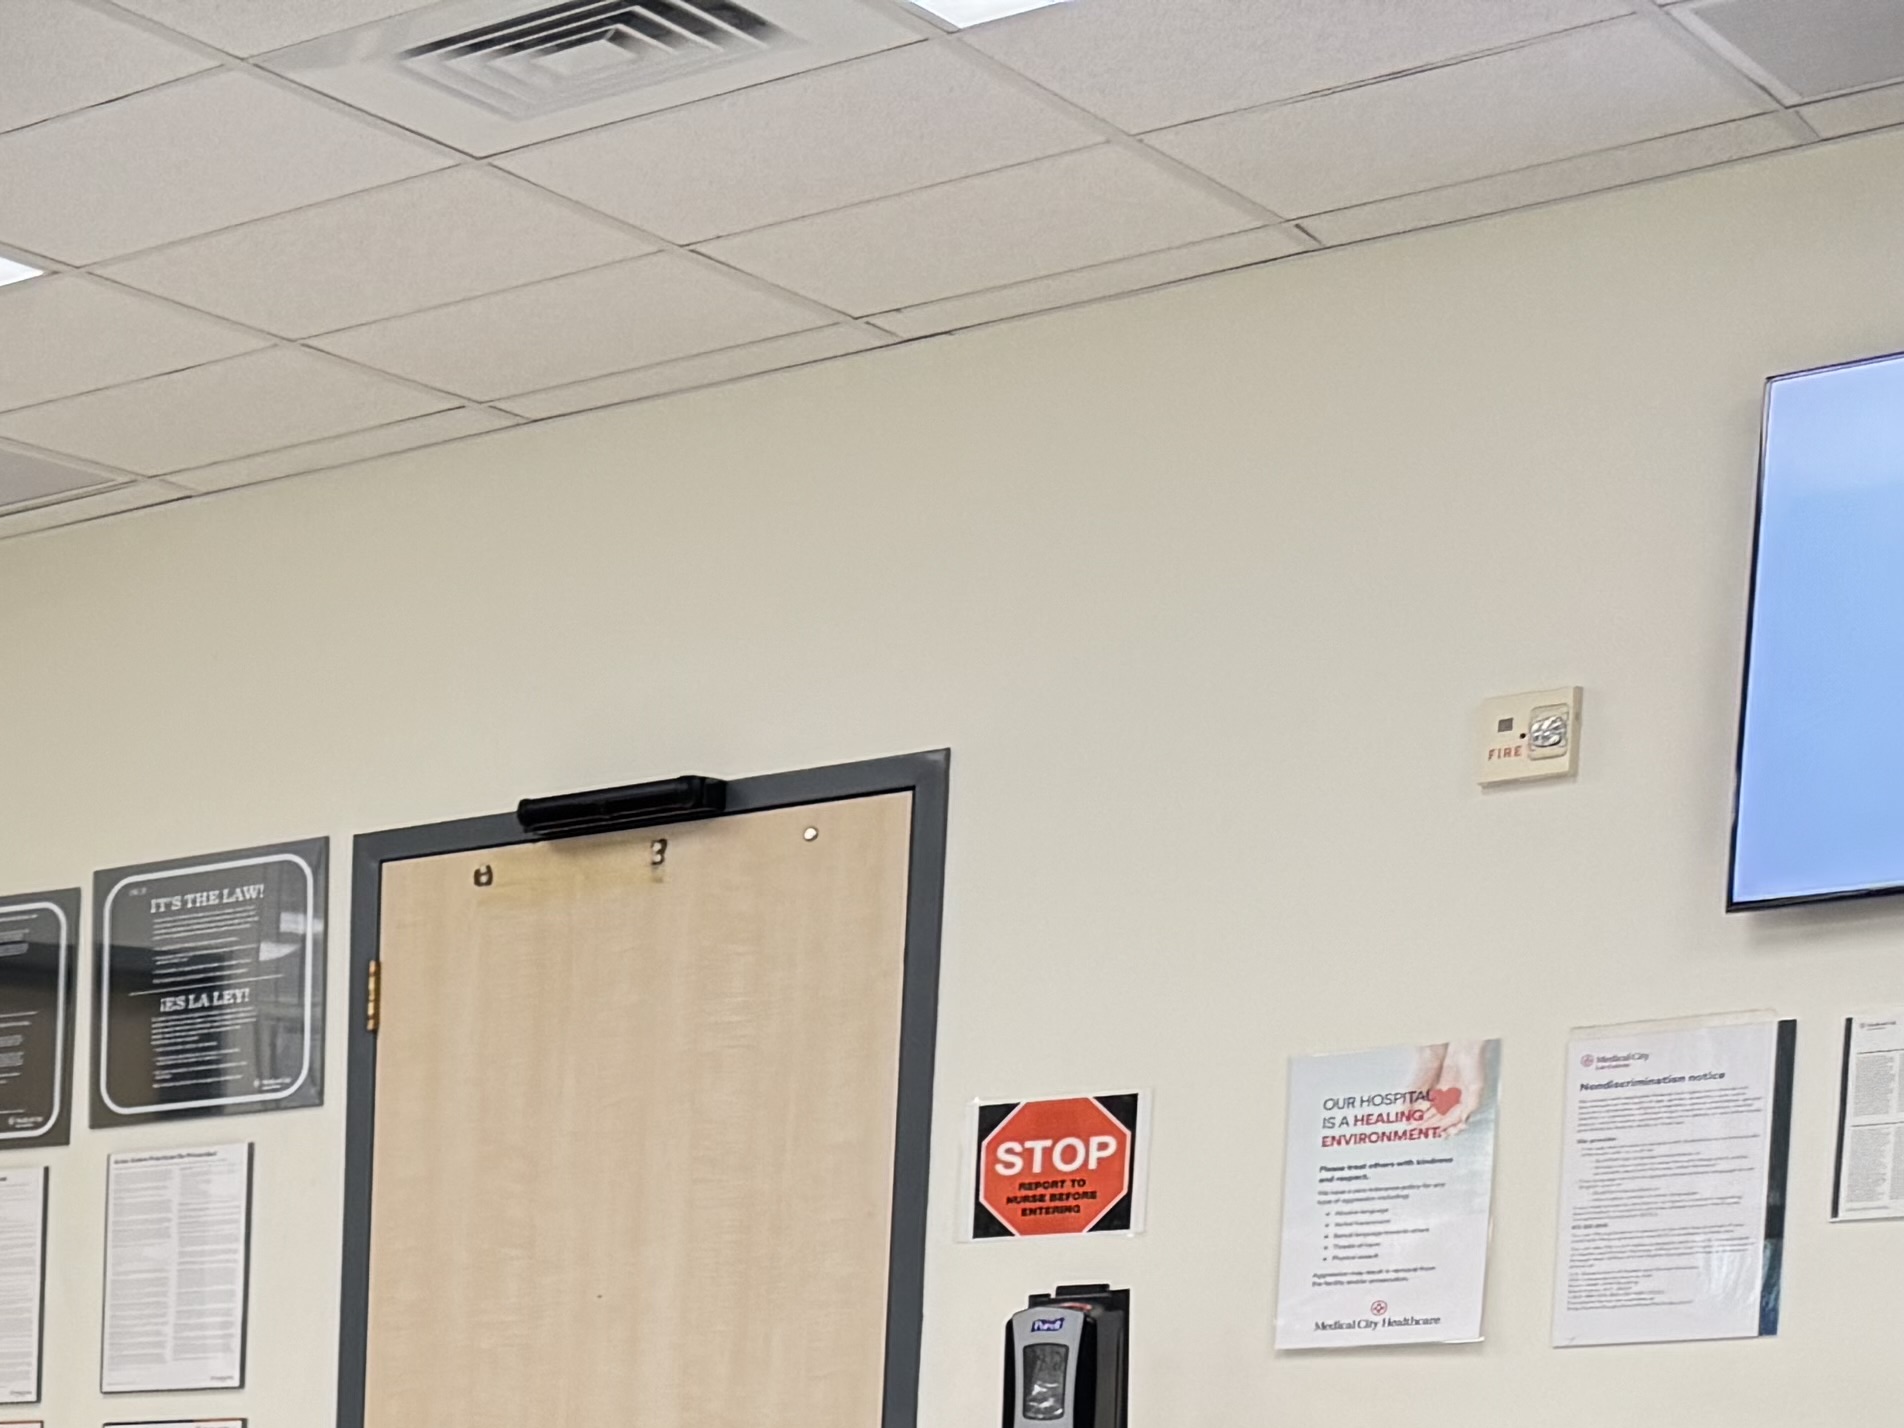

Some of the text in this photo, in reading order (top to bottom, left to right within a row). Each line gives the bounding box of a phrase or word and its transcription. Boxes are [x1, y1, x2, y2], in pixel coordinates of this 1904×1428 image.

[1487, 745, 1522, 761] FIRE
[150, 884, 264, 913] IT'S THE LAW!
[213, 988, 250, 1006] LEY!
[1579, 1071, 1726, 1092] Nondiscrimination notice
[1323, 1090, 1435, 1111] OUR HOSPITAL
[1322, 1109, 1424, 1129] IS A HEALING
[1321, 1126, 1442, 1147] ENVIRONMENT.
[994, 1135, 1118, 1176] STOP
[1018, 1178, 1087, 1191] REPORT TO
[1006, 1190, 1097, 1205] NURSE BEFORE
[1021, 1204, 1081, 1217] ENTERING
[1313, 1315, 1441, 1332] Medical City Healthcare
